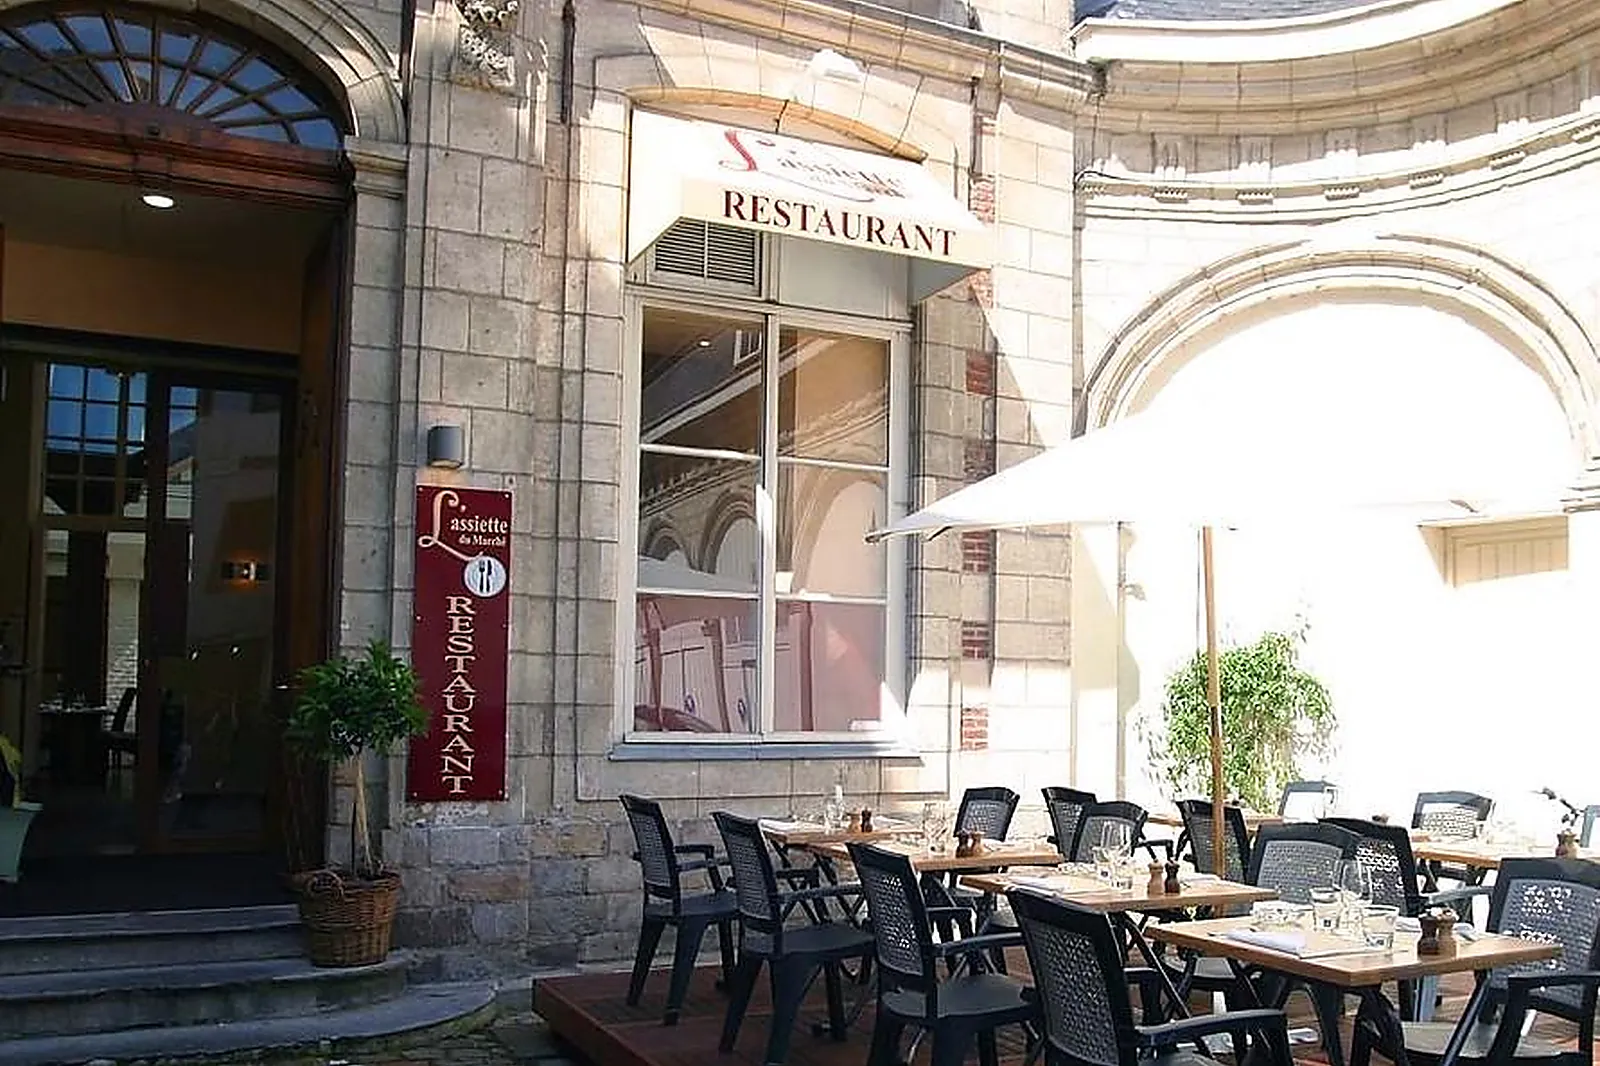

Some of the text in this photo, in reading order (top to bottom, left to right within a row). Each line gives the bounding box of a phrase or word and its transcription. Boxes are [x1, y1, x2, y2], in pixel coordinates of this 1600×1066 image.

[724, 190, 957, 256] RESTAURANT
[418, 490, 508, 562] L'assiette
[441, 596, 476, 794] RESTAURANT
